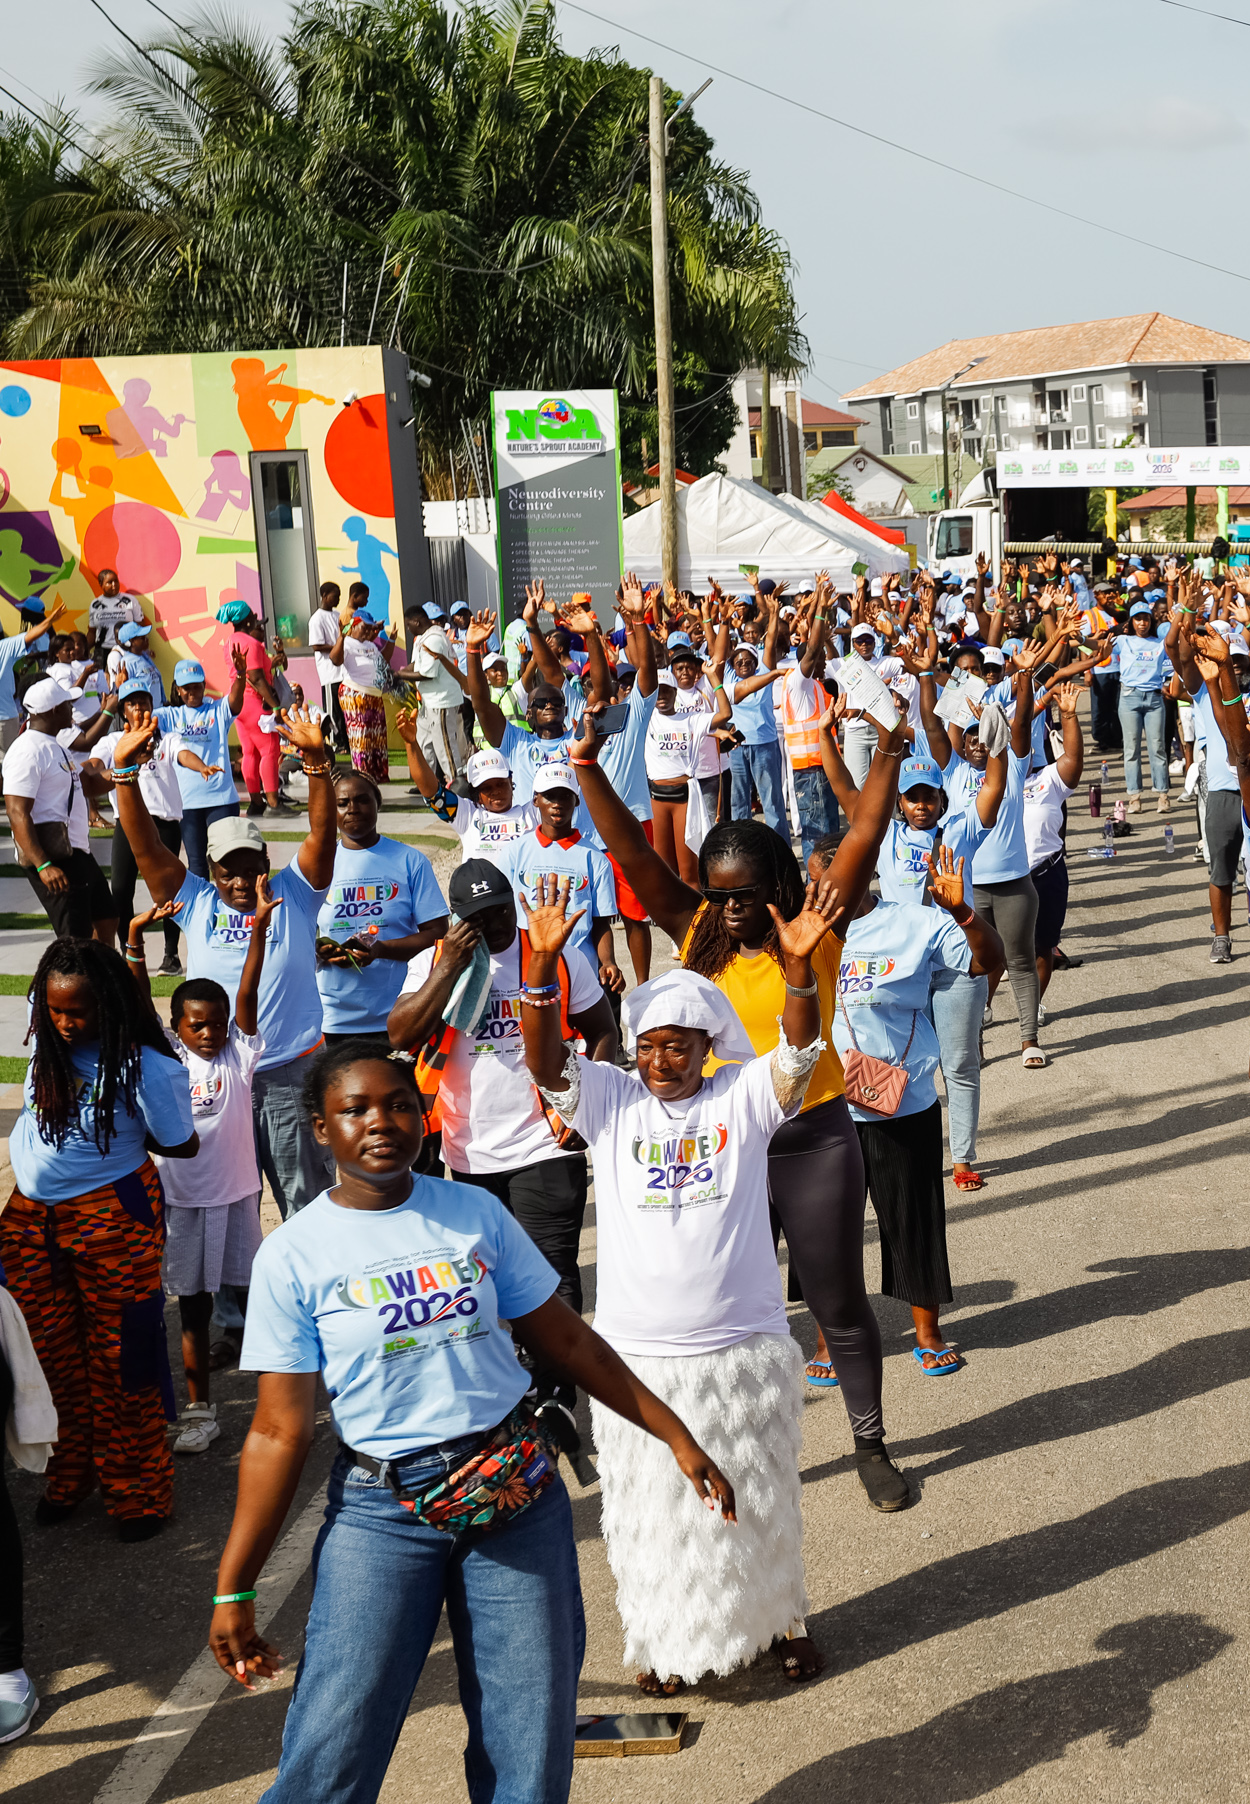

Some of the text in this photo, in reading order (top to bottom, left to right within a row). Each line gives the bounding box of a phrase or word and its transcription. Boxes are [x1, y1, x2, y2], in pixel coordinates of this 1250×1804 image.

[505, 398, 602, 439] NSA
[507, 441, 600, 452] NATURE'S SPROUT ACADEMY
[1152, 454, 1173, 463] AWARE
[1152, 464, 1173, 473] 2026
[508, 487, 606, 500] Neurodiversity
[508, 500, 553, 511] Centre
[181, 726, 208, 736] 2026
[658, 733, 687, 741] AWARE
[659, 742, 687, 750] 2026
[482, 820, 521, 834] AWARE
[334, 886, 384, 903] AWARE
[334, 902, 383, 918] 2026
[218, 914, 256, 928] AWA
[840, 960, 876, 977] WARE
[838, 976, 873, 994] 026
[476, 1020, 522, 1040] 202
[648, 1136, 711, 1166] AWARE
[647, 1160, 713, 1190] 2026
[370, 1258, 473, 1304] AWARE
[378, 1286, 478, 1335] 2026
